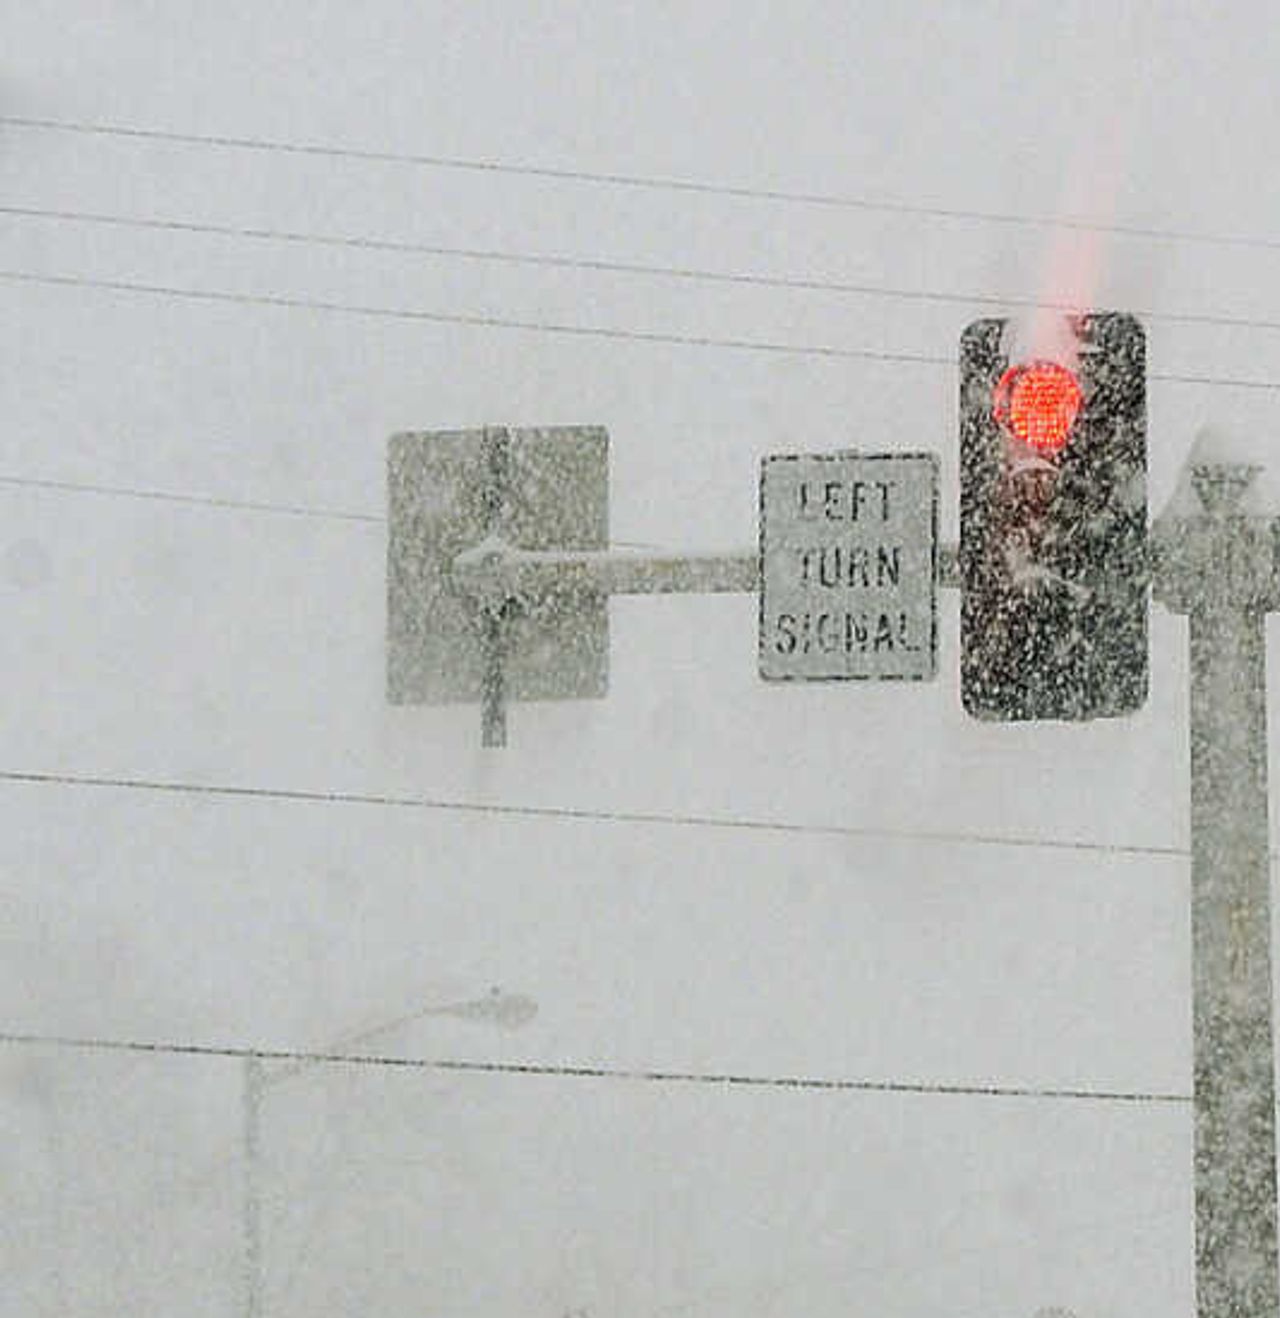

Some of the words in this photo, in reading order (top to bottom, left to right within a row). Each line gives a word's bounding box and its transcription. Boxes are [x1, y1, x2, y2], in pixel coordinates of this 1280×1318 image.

[797, 481, 897, 523] LEFT
[796, 546, 902, 589] TURN
[774, 612, 921, 655] SIGNAL
